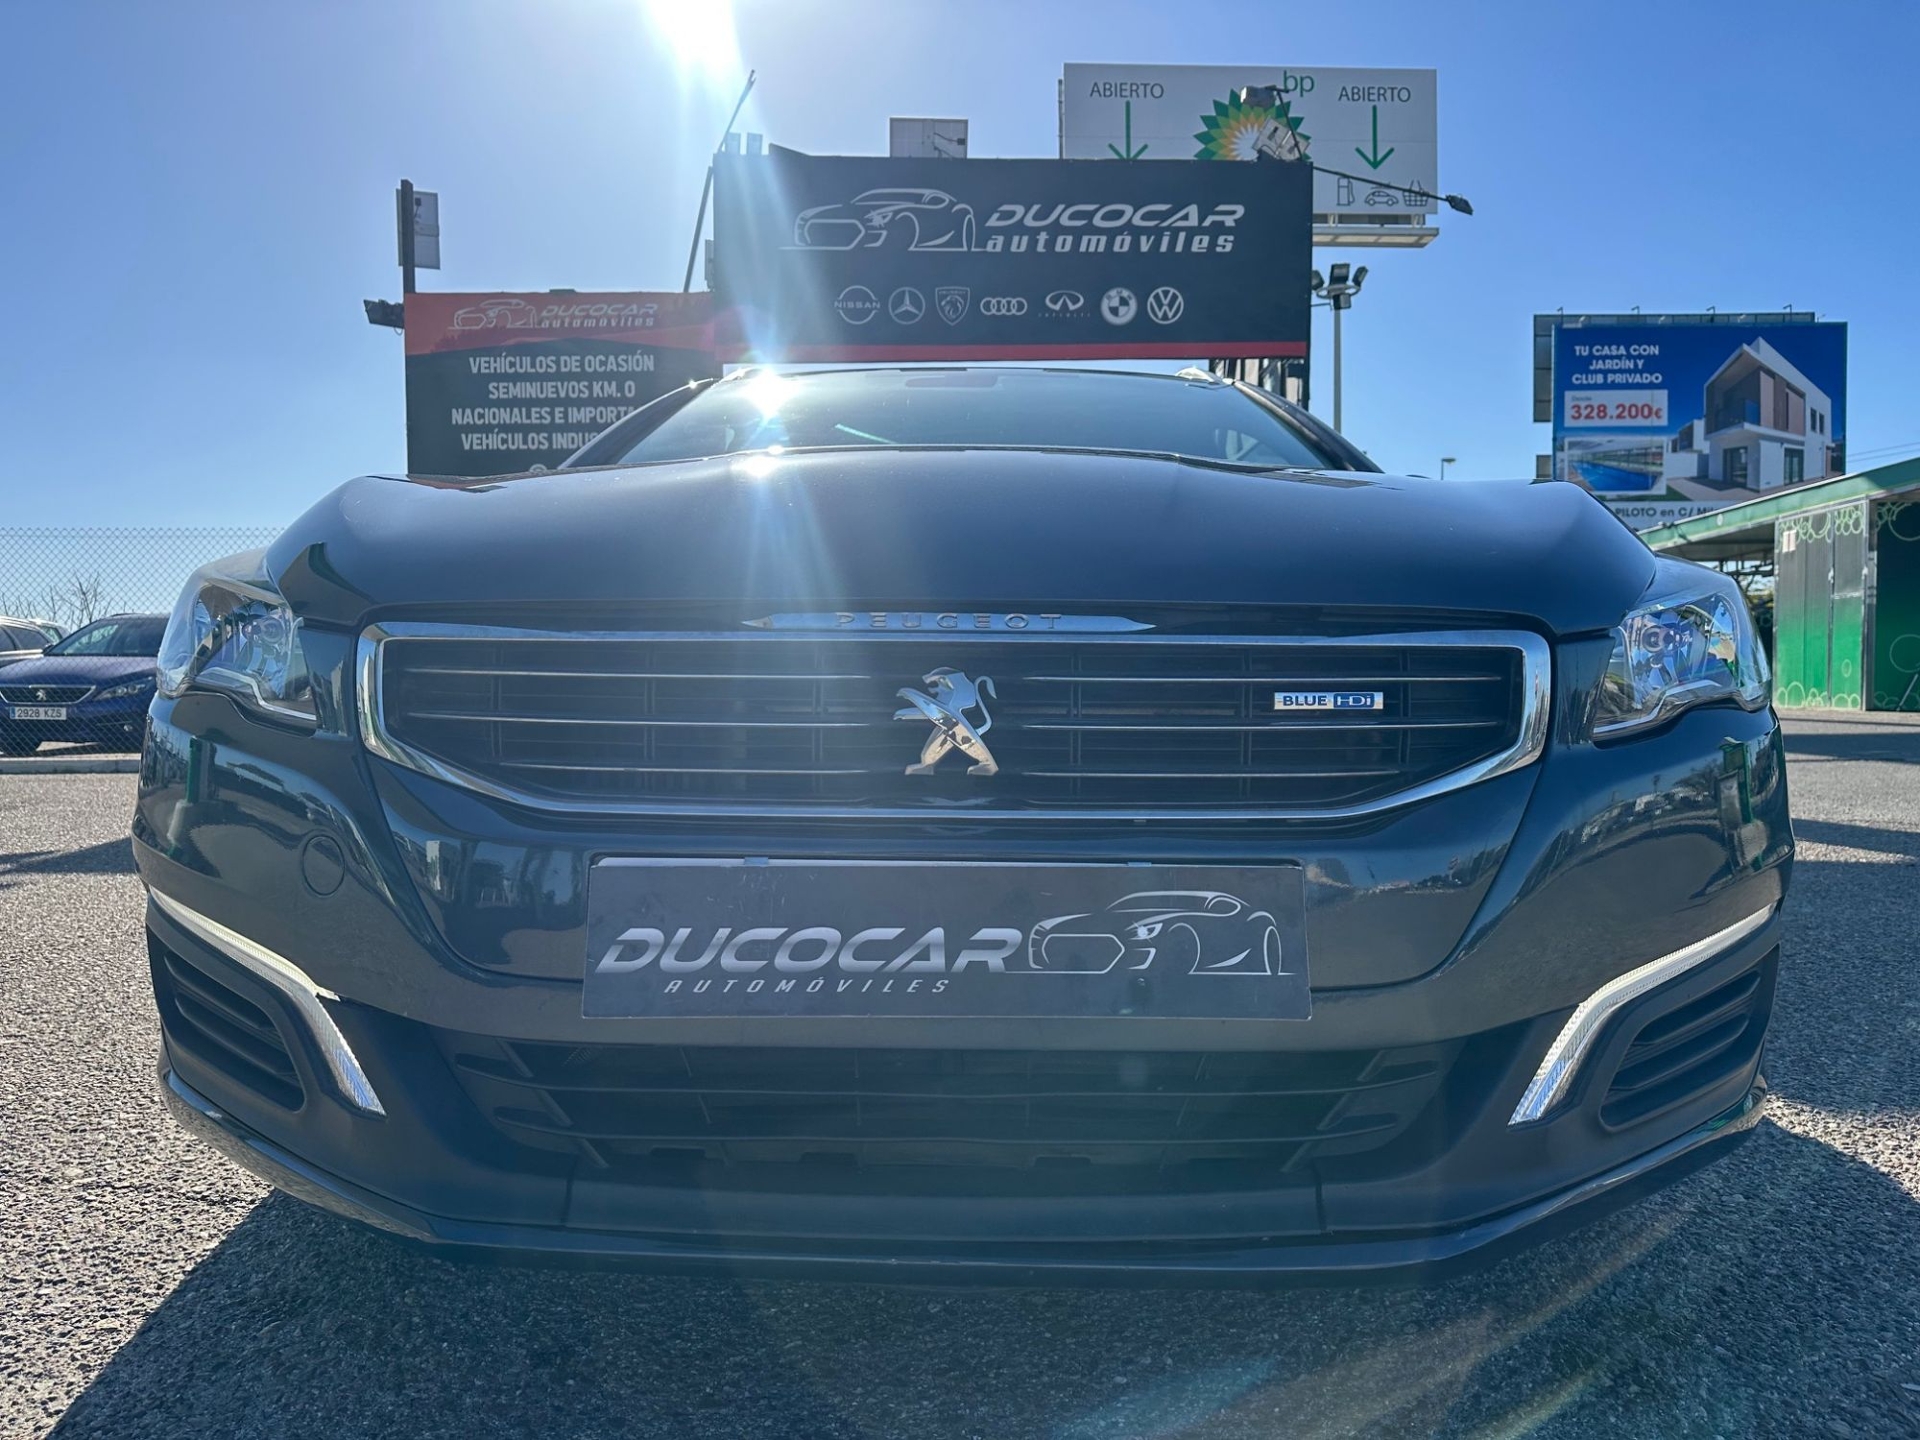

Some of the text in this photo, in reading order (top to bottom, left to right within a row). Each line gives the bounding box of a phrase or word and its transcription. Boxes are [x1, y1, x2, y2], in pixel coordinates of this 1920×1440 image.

[1090, 81, 1165, 100] ABIERTO
[1284, 69, 1315, 97] bp
[1338, 85, 1412, 104] ABIERTO
[985, 204, 1246, 228] DUCOCAR
[986, 229, 1235, 254] automóviles
[541, 303, 659, 317] DUCOCAR
[833, 301, 881, 310] NISSAN
[1574, 344, 1660, 356] TU CASA CON
[469, 349, 655, 374] VEHÍCULOS DE OCASIÓN
[1589, 356, 1644, 370] JARDÍN Y
[1572, 373, 1662, 384] CLUB PRIVADO
[488, 381, 590, 400] SEMINUEVOS
[592, 381, 622, 398] KM.
[452, 407, 551, 425] NACIONALES
[555, 408, 565, 424] E
[461, 428, 549, 451] VEHÍCULOS
[1660, 508, 1675, 517] en
[835, 612, 1065, 630] PEUGEOT
[1283, 695, 1328, 707] BLUE
[17, 708, 62, 718] 2928 KZS
[594, 926, 1024, 974] DUCOCAR
[664, 974, 951, 994] AUTOMÓVILES
